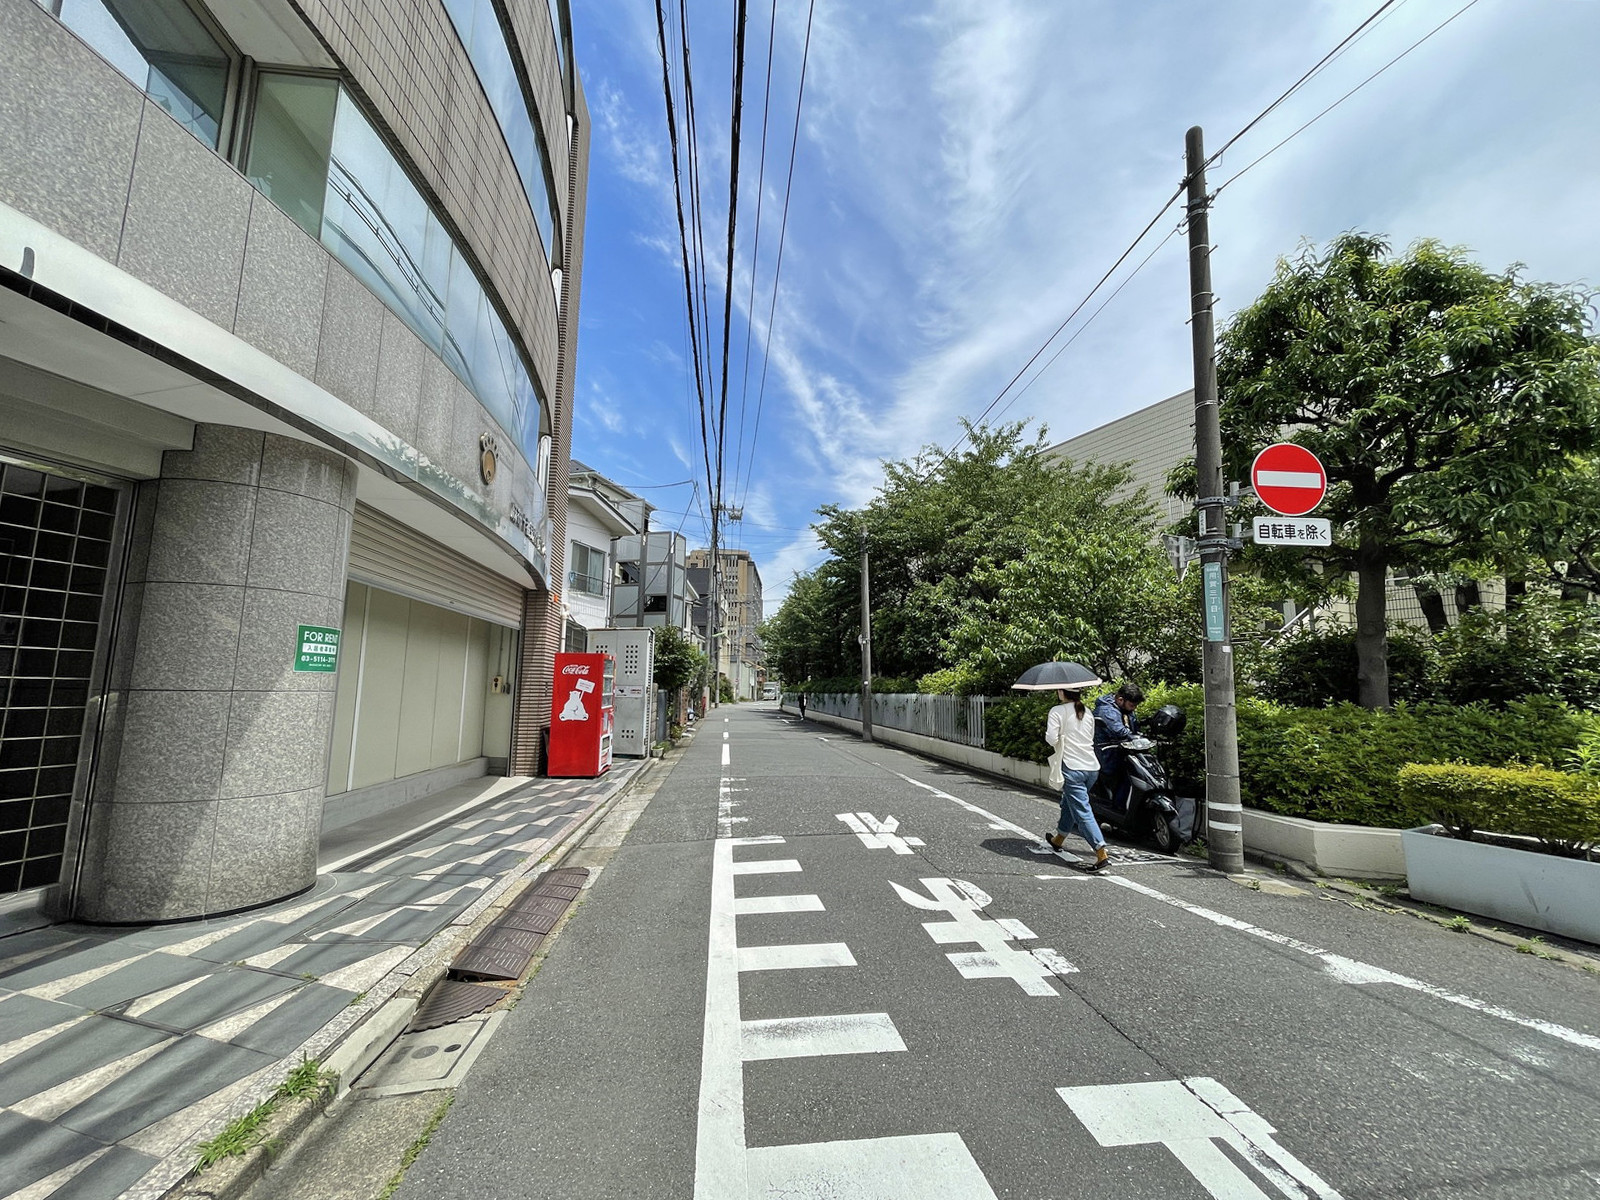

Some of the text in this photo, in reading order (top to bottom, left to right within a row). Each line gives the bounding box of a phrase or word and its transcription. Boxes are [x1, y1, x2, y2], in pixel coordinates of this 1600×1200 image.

[1259, 524, 1327, 540] 自転車を除く
[304, 631, 323, 641] FOR
[301, 655, 335, 663] 03-5114-
